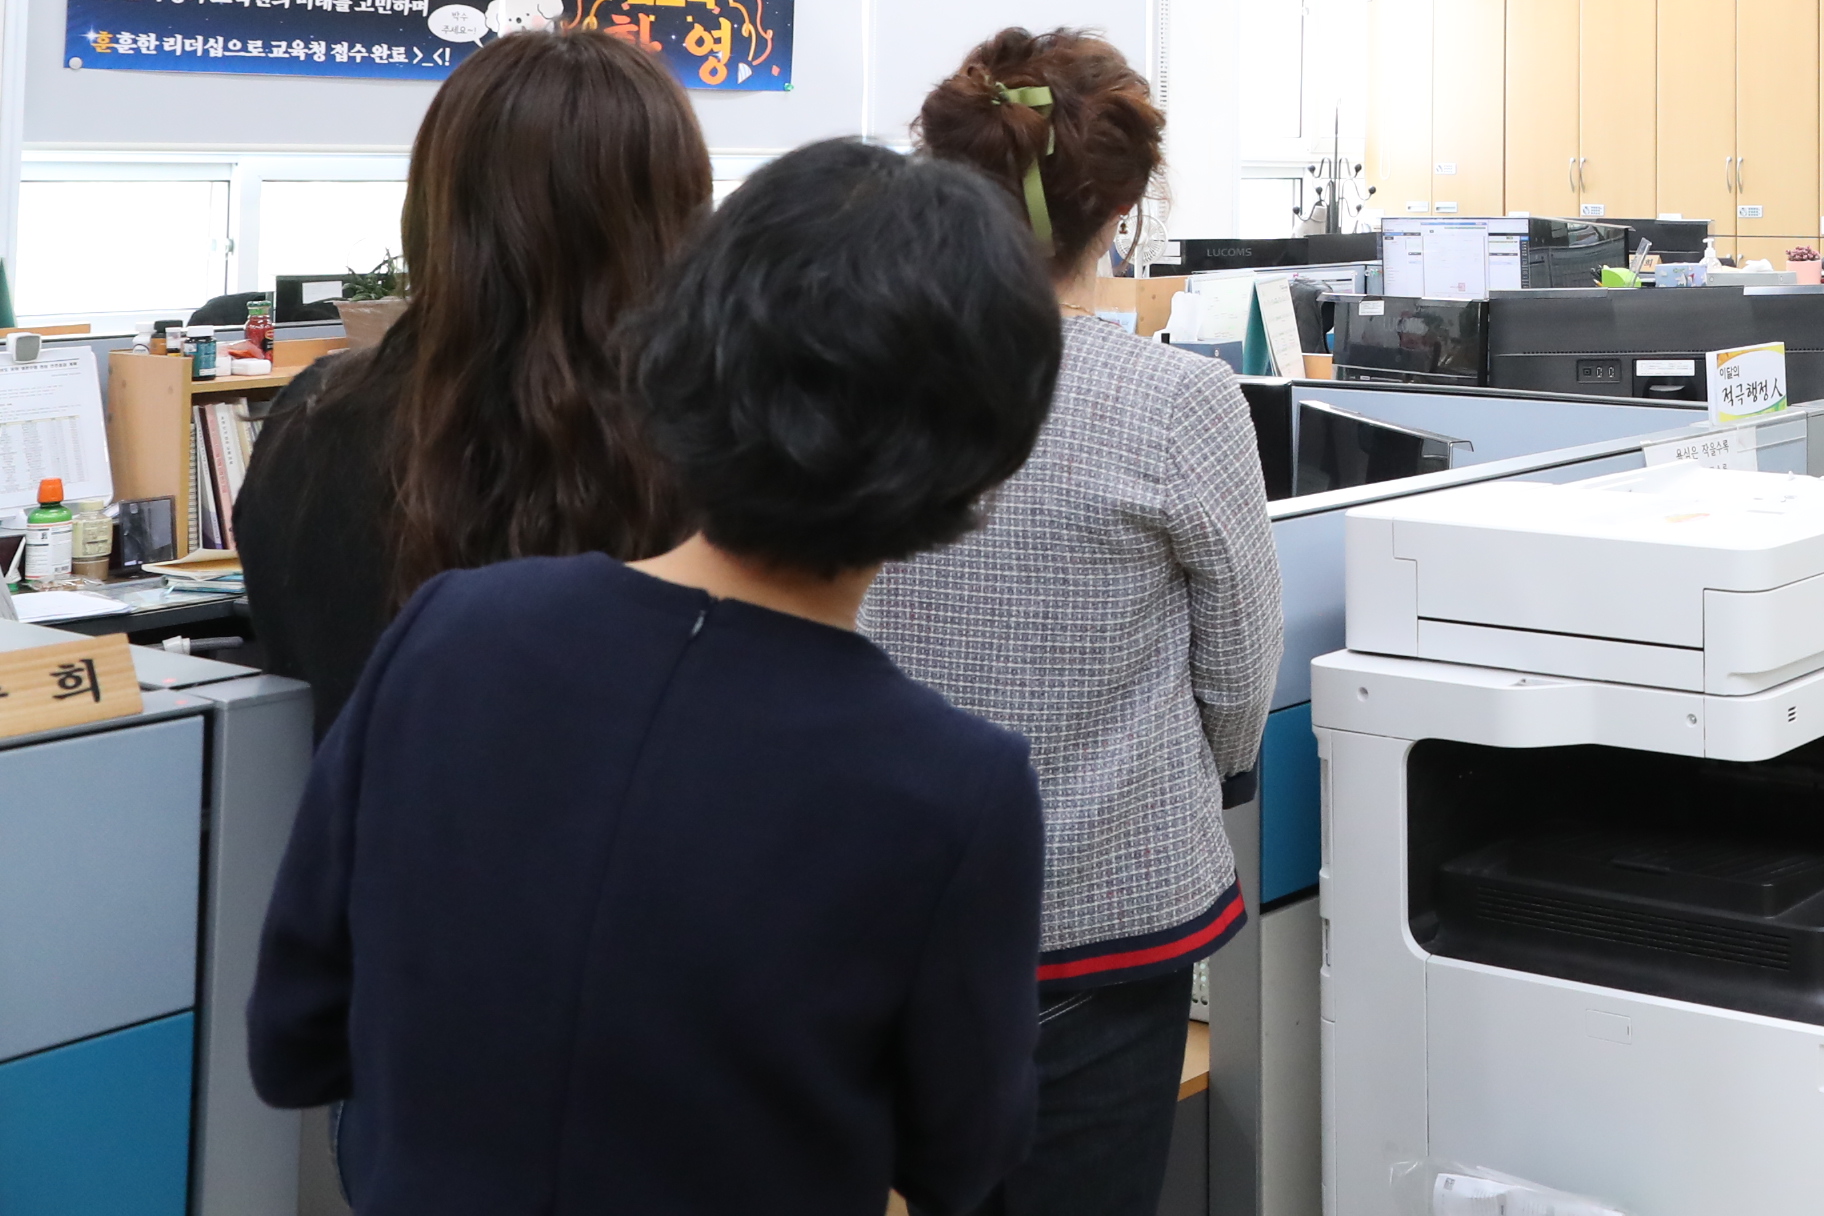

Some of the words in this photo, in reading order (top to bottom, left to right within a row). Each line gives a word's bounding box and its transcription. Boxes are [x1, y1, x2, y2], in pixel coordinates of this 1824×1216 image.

[451, 11, 469, 21] 박수
[91, 30, 158, 54] 훈훈한
[162, 34, 265, 58] 리더십으로
[267, 38, 327, 62] 교육청
[1206, 247, 1253, 257] LUCOMS
[1719, 365, 1740, 380] 이달의
[1702, 439, 1730, 458] 작을수록
